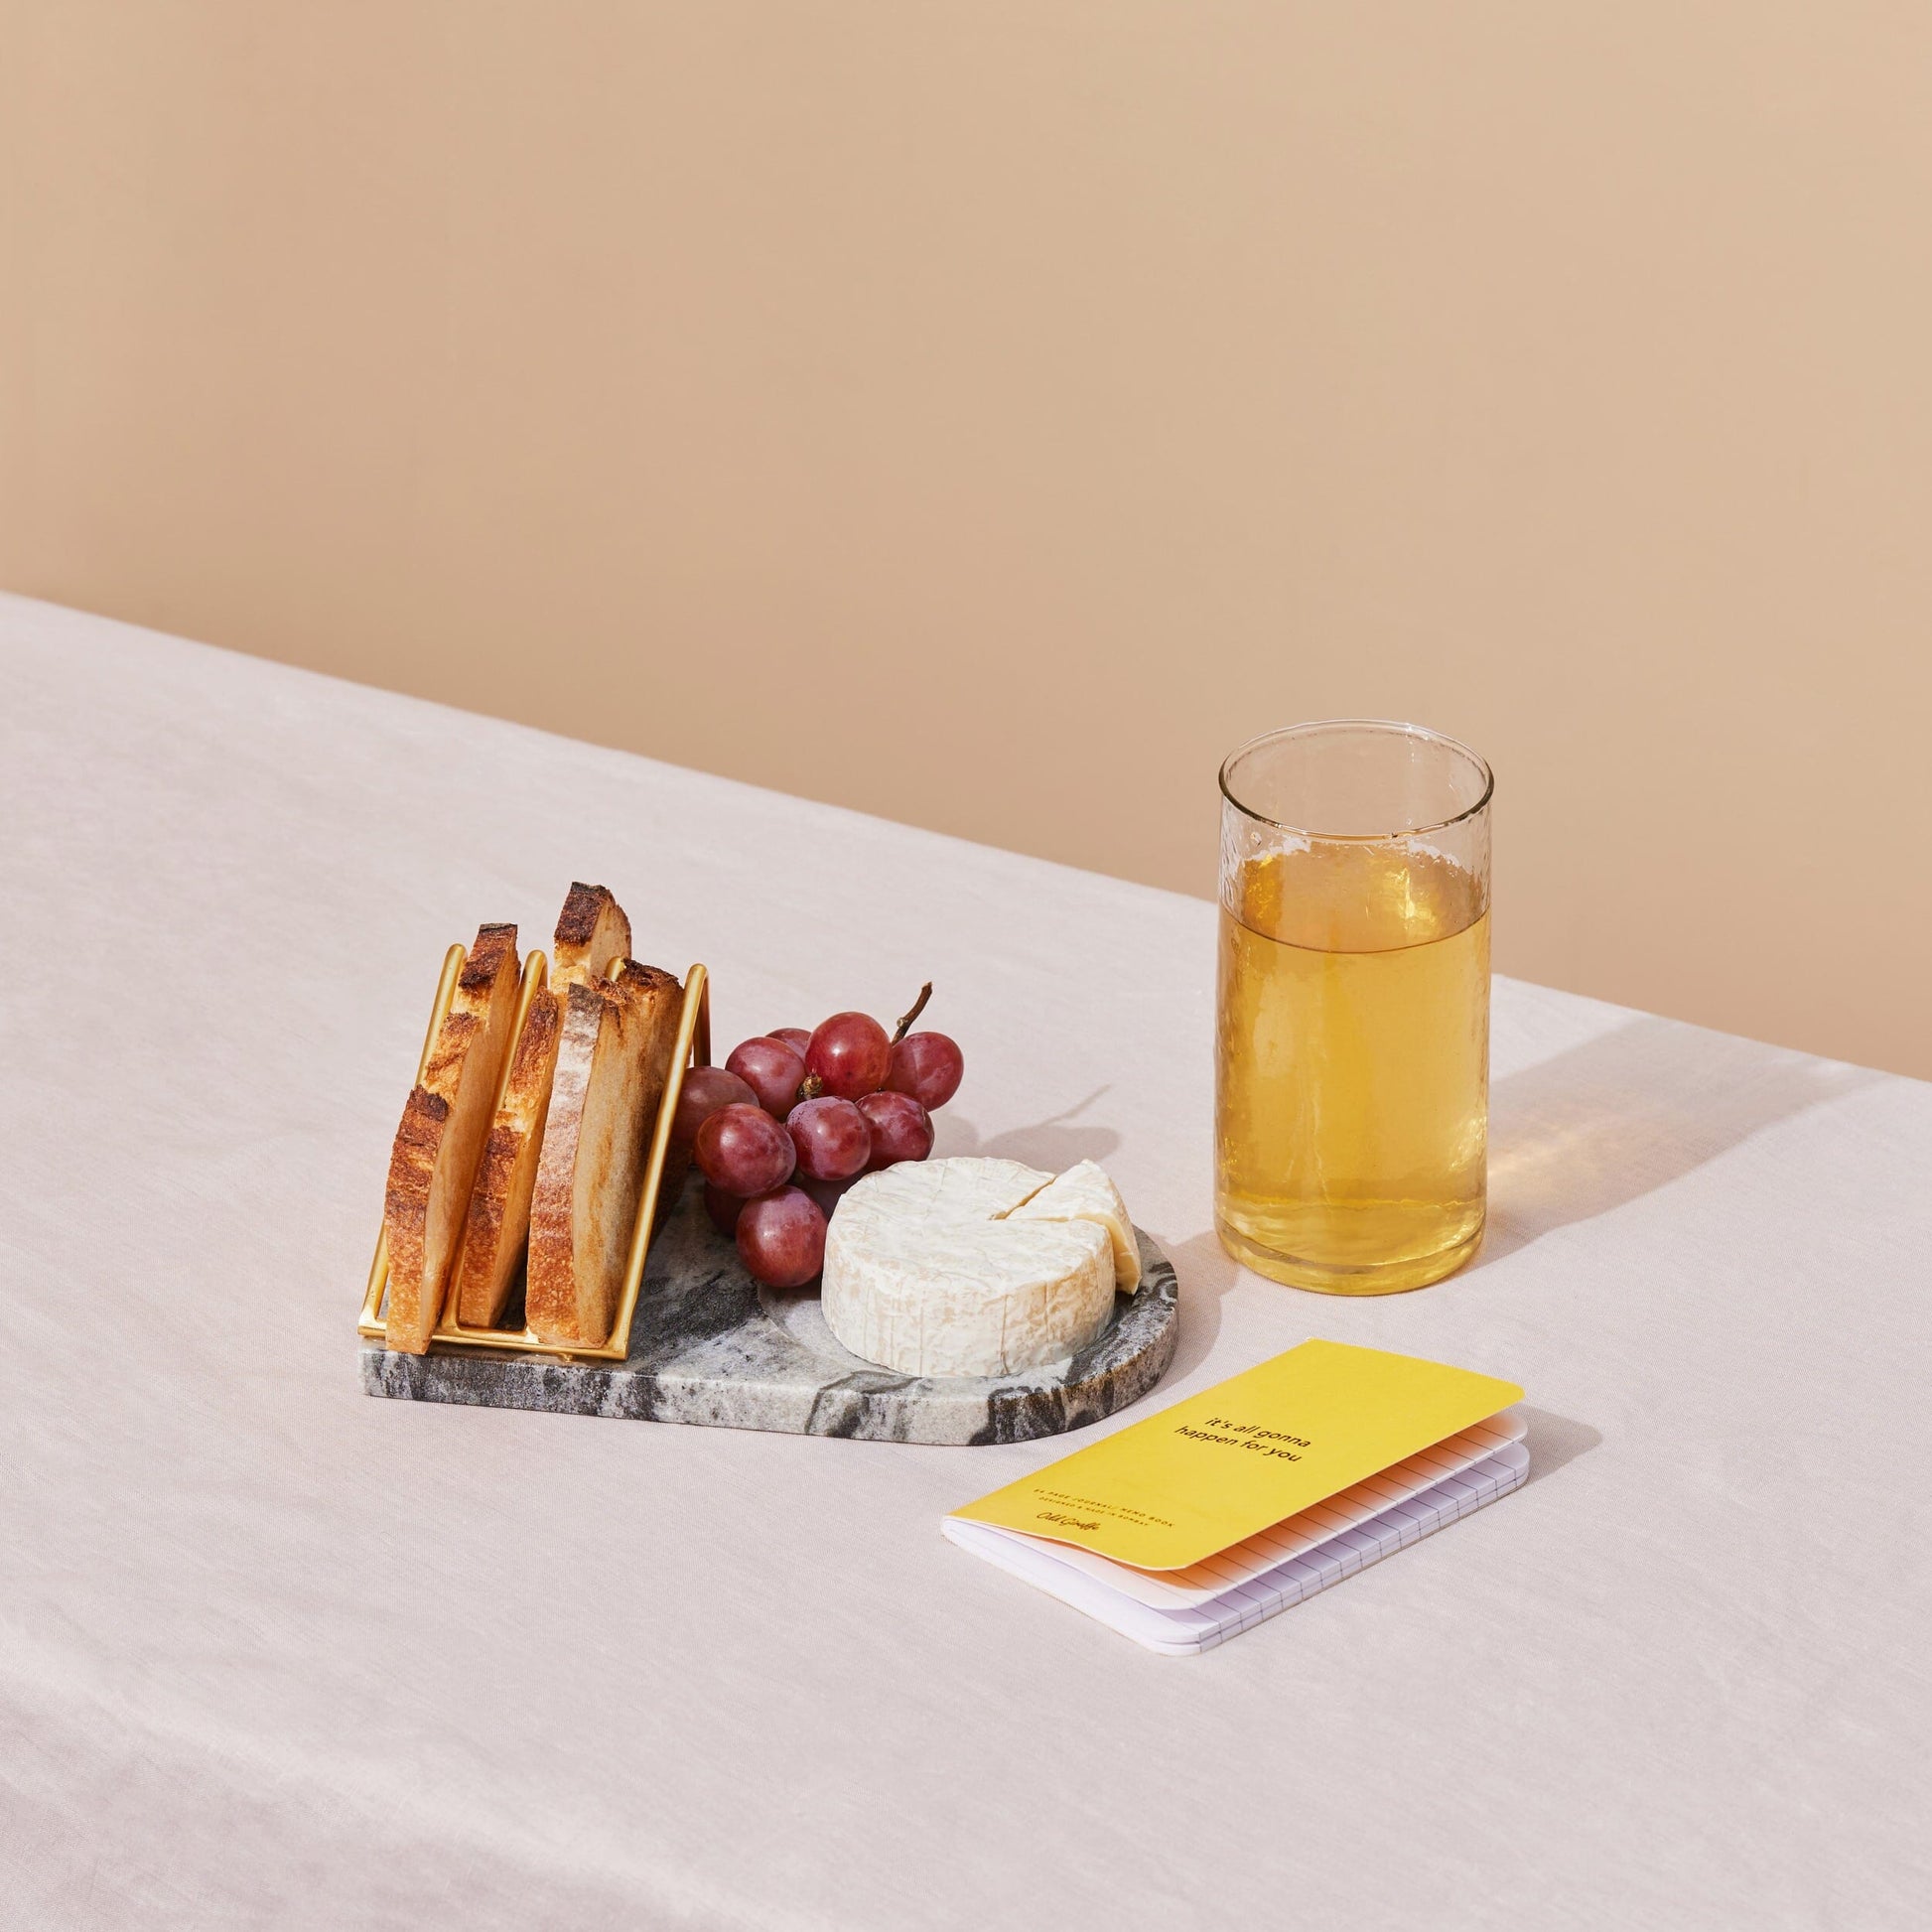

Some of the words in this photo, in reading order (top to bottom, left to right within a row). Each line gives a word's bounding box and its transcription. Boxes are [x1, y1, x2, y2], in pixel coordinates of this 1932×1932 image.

[1174, 1426, 1238, 1446] happen
[1240, 1440, 1268, 1451] for
[1262, 1448, 1303, 1462] you
[1204, 1417, 1233, 1430] it's
[1233, 1425, 1261, 1434] all
[1253, 1430, 1311, 1448] gonna
[1148, 1516, 1174, 1527] BOOK
